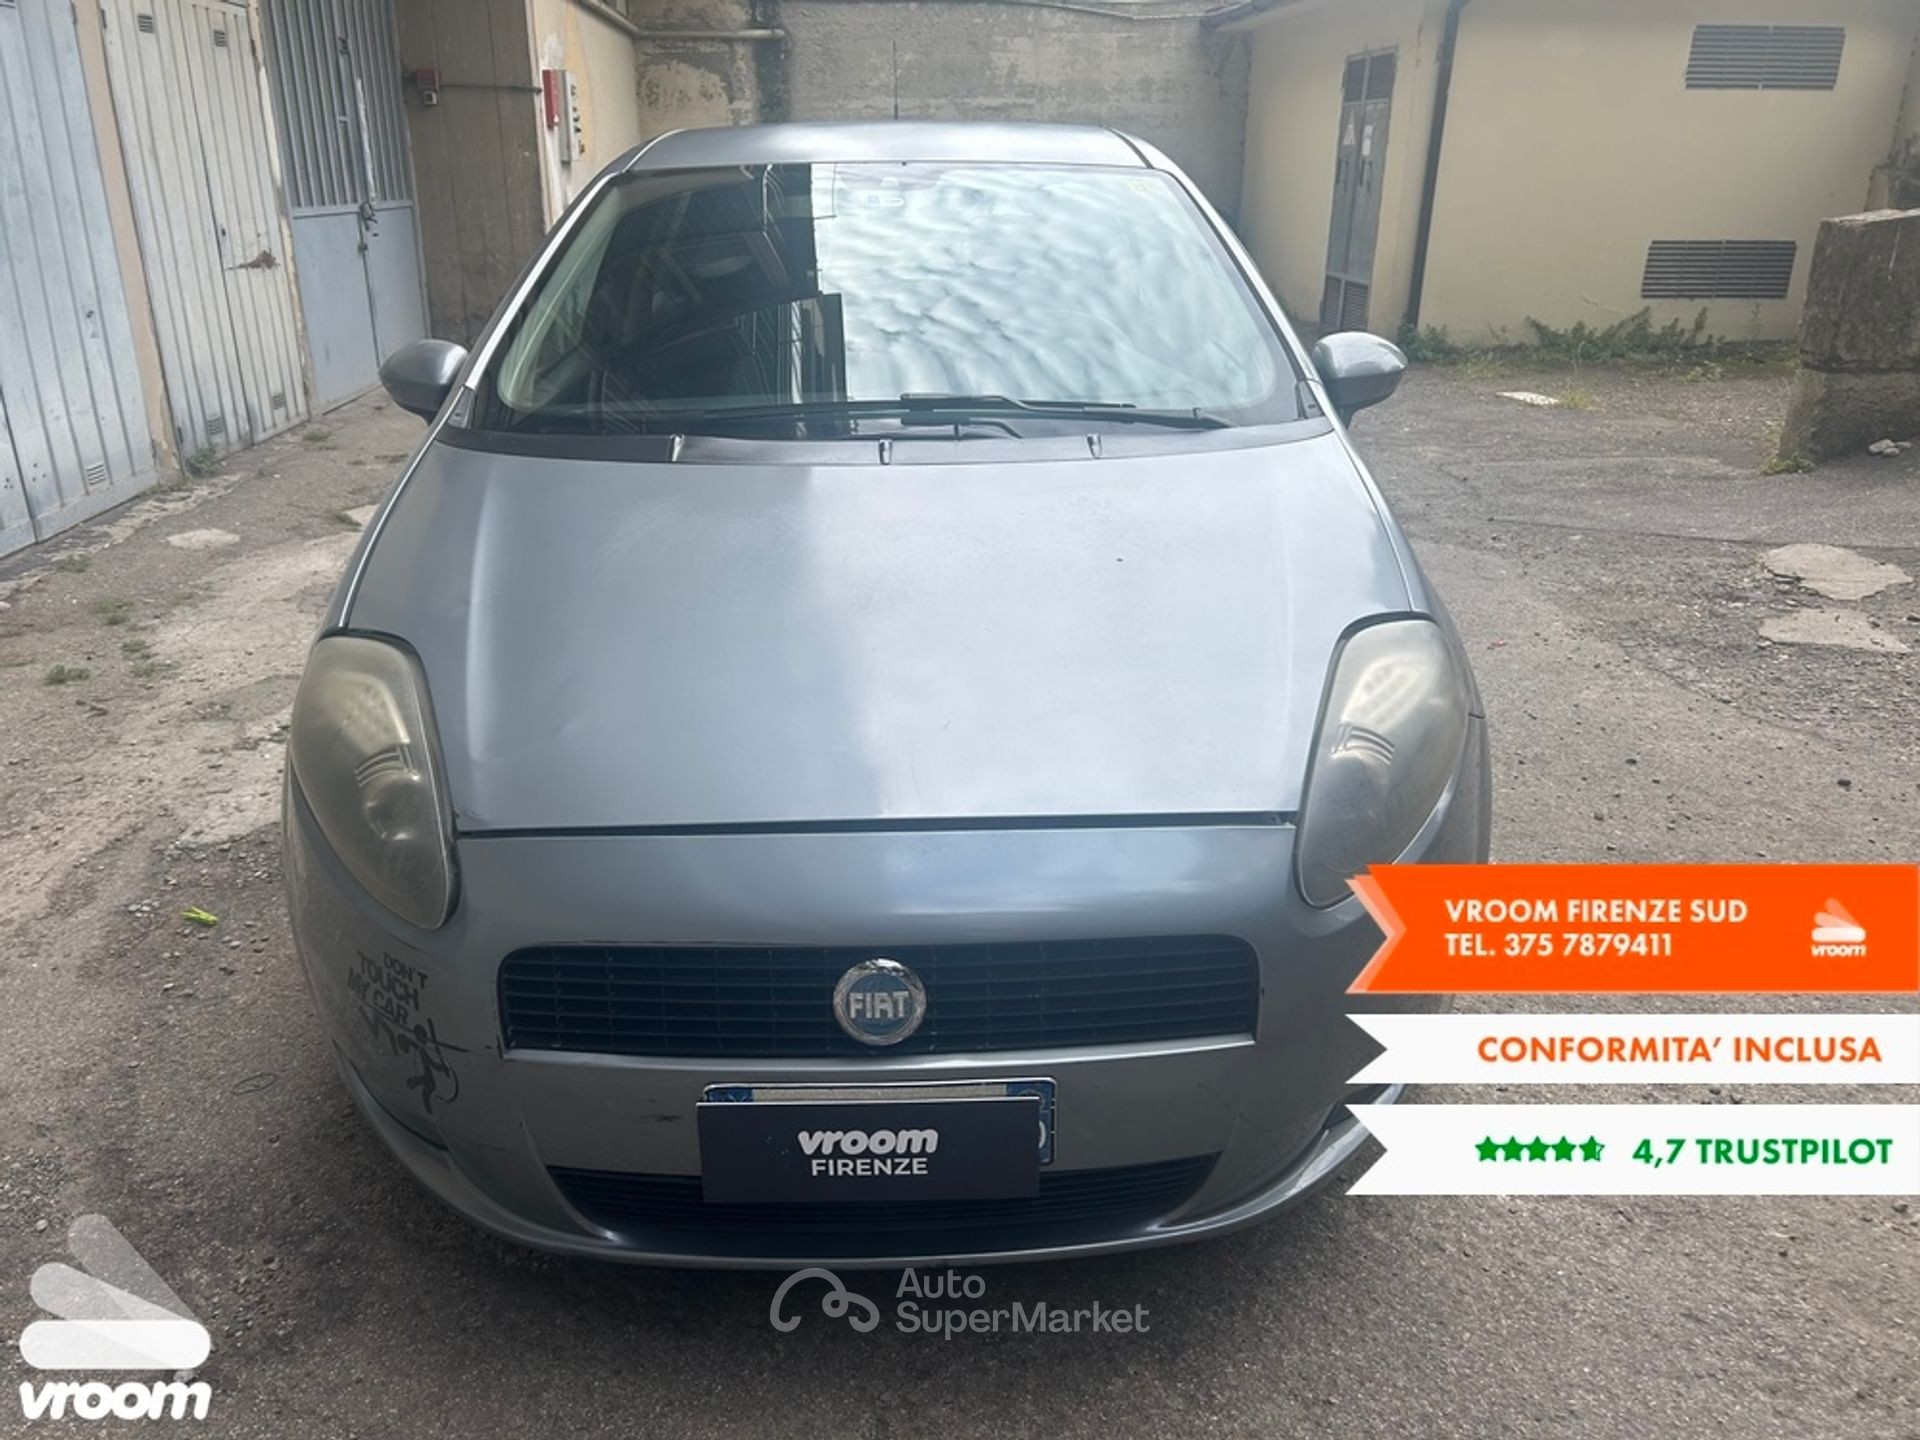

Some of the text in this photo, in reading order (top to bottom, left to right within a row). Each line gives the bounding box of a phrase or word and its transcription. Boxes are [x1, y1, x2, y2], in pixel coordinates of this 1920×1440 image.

[357, 950, 420, 1011] TOUCH
[373, 991, 409, 1025] CAR
[849, 991, 909, 1019] FIAT
[797, 1128, 939, 1155] vroom
[811, 1158, 929, 1177] FIRENZE
